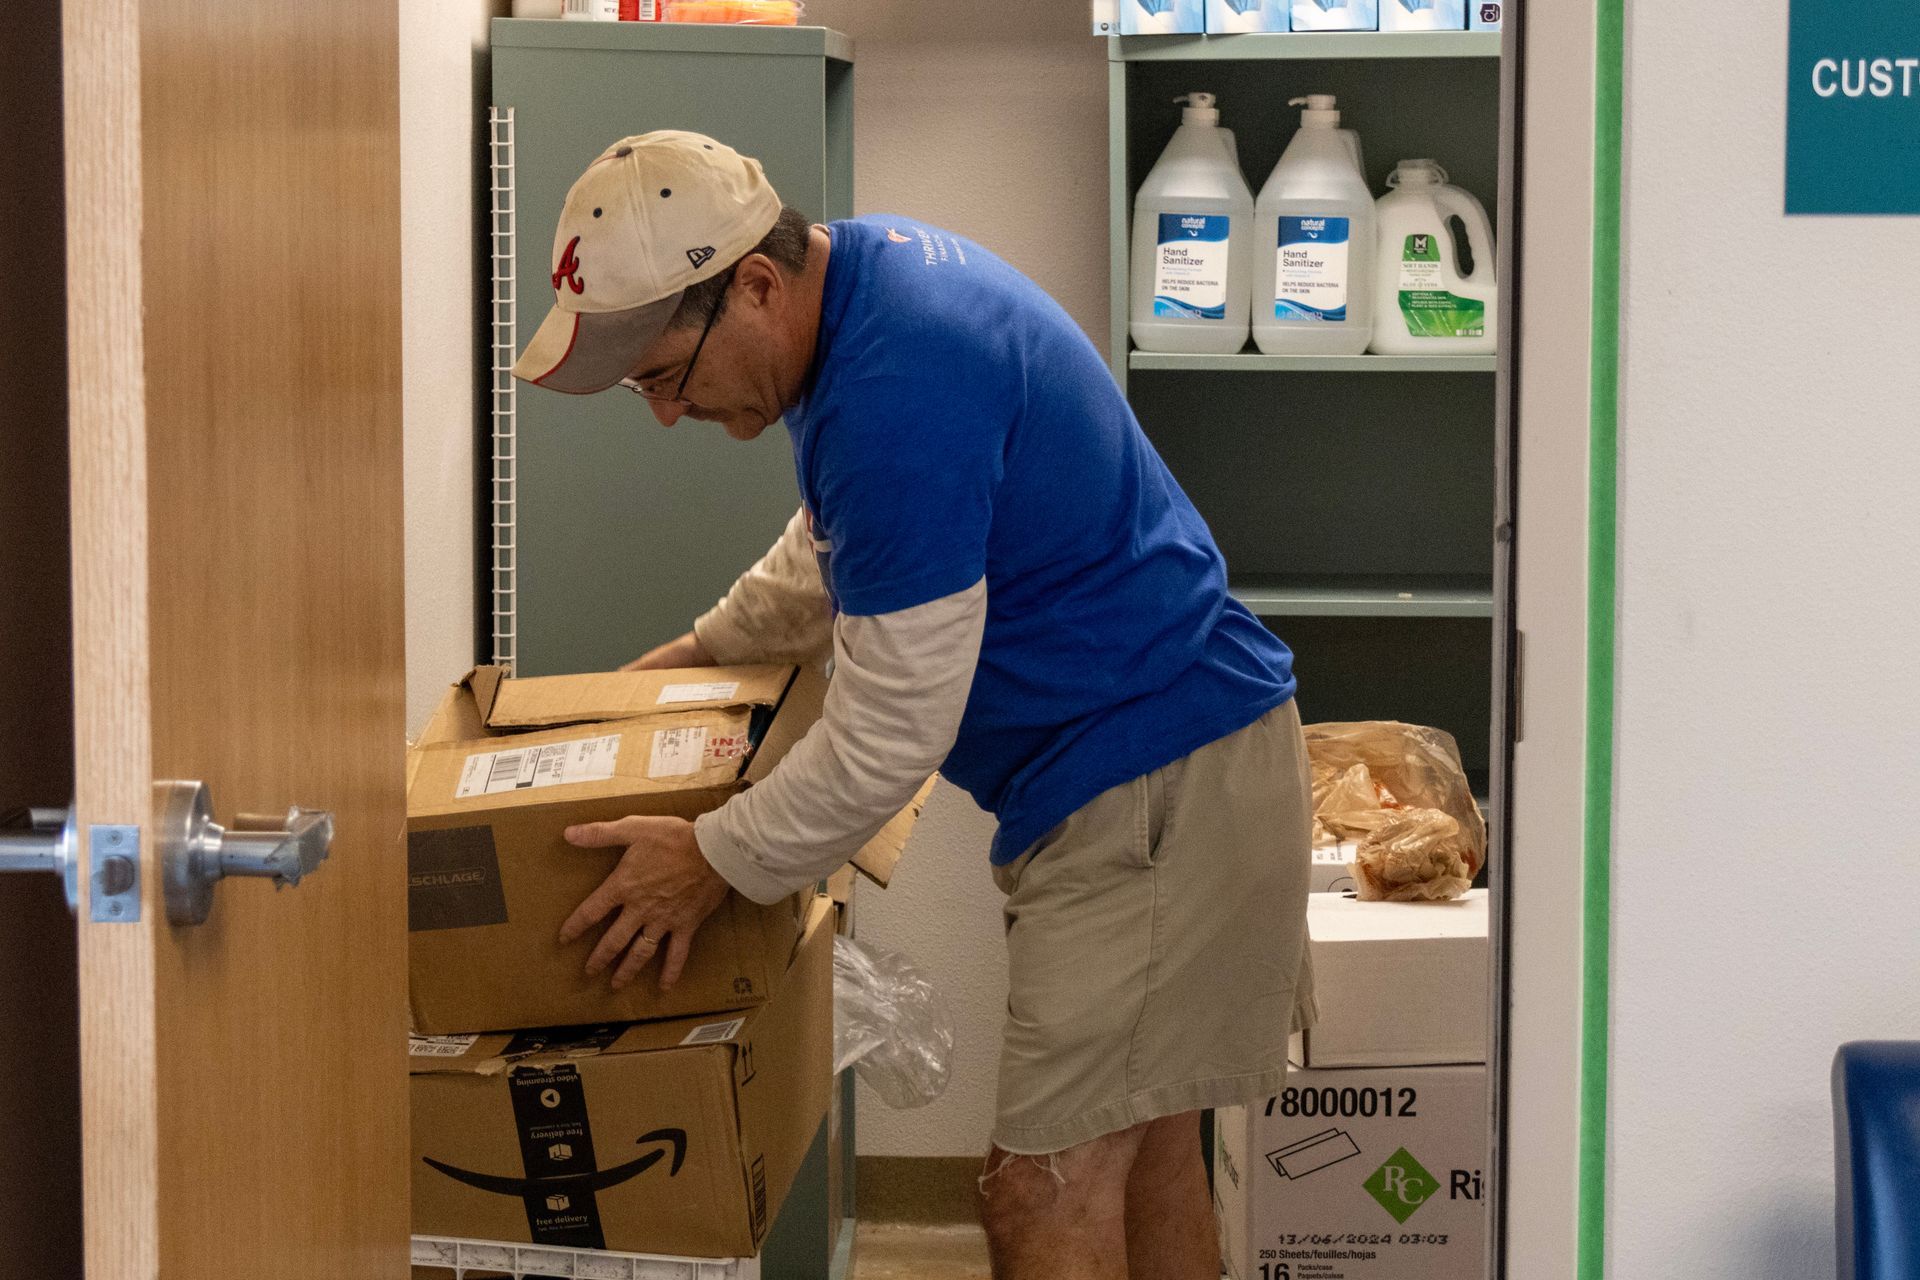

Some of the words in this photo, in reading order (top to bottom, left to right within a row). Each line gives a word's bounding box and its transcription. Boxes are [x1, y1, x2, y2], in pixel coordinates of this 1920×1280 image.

[1811, 58, 1920, 97] CUST
[1163, 247, 1188, 256] Hand
[1283, 250, 1307, 258] Hand
[1163, 256, 1204, 265] Sanitizer
[1283, 259, 1324, 267] Sanitizer
[408, 871, 481, 886] SCHLAGE
[516, 1077, 556, 1087] streaming
[556, 1074, 578, 1083] video
[531, 1130, 564, 1139] delivery
[567, 1128, 583, 1136] free
[1450, 1169, 1485, 1206] Ri
[555, 1215, 588, 1224] delivery
[1259, 1250, 1276, 1259] 250
[1279, 1249, 1376, 1261] Sheets/feuilles/hojas
